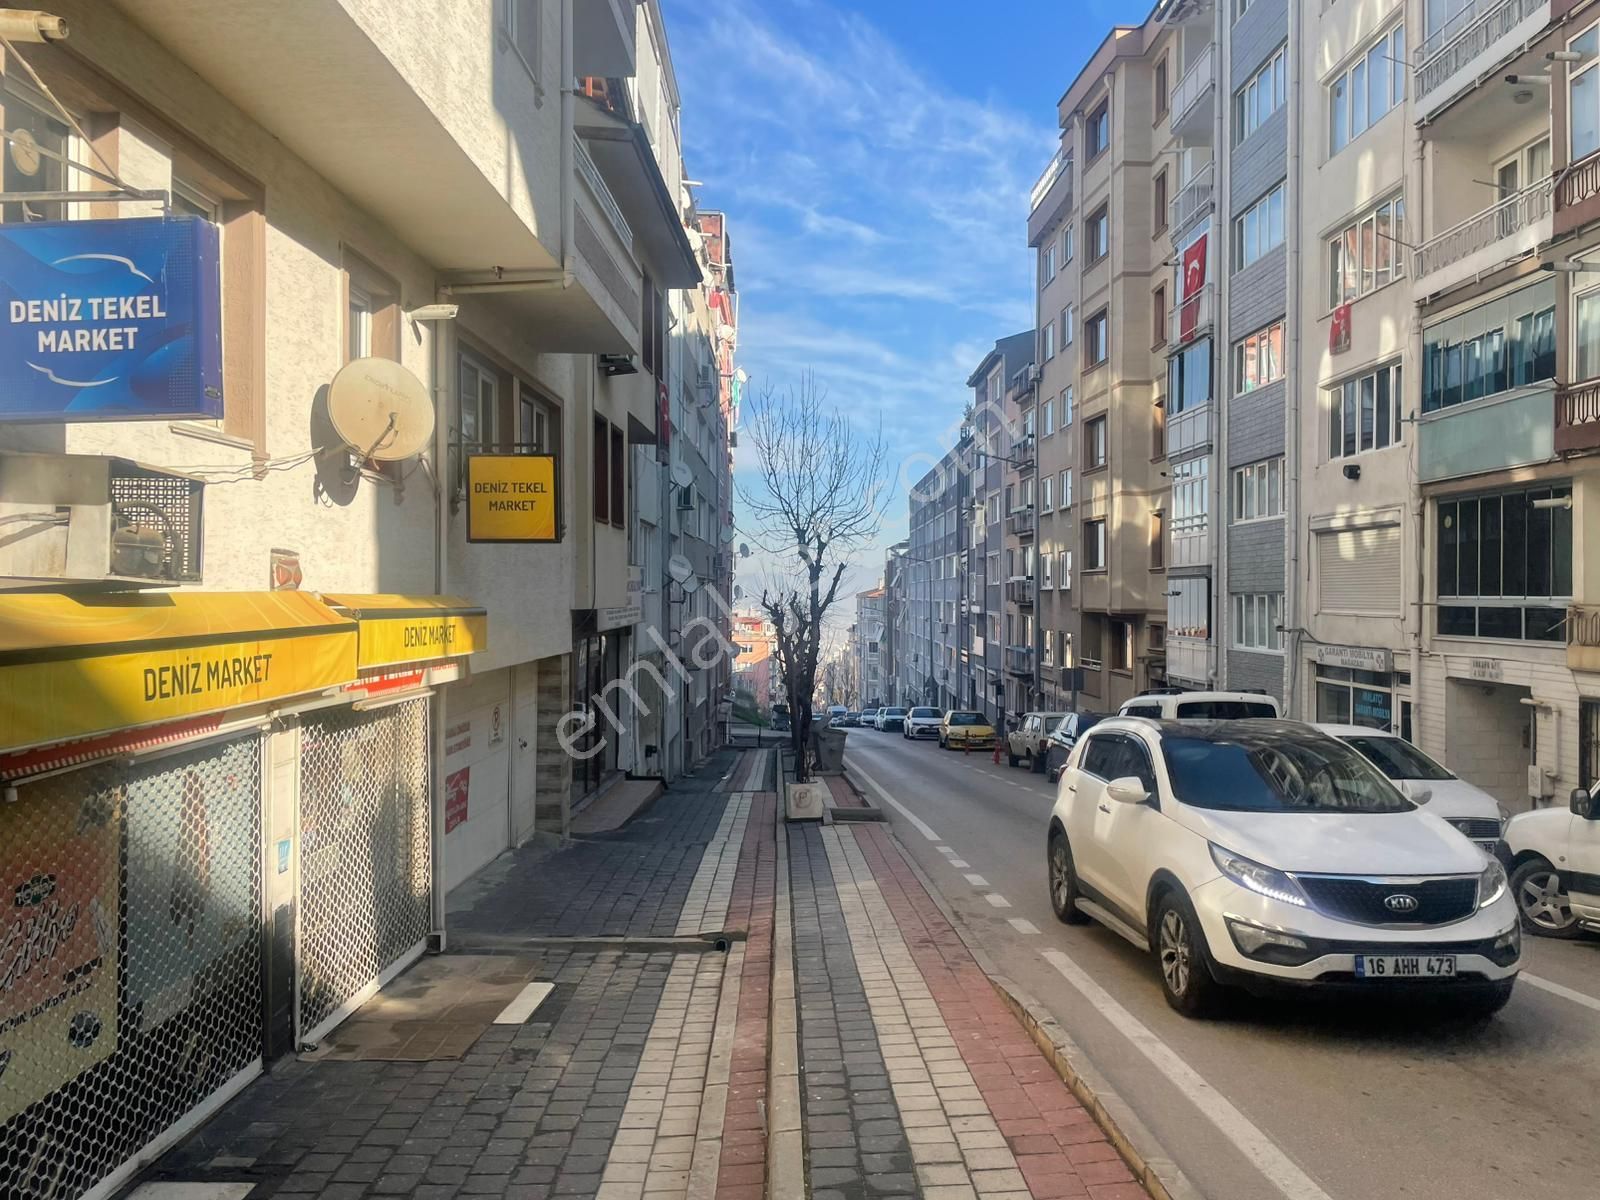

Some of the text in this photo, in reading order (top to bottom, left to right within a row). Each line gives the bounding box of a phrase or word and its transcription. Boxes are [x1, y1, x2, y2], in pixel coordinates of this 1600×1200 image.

[10, 292, 166, 323] DENİZ TEKEL
[38, 327, 138, 352] MARKET
[474, 481, 547, 493] DENİZ TEKEL
[488, 500, 536, 511] MARKET
[404, 621, 456, 647] DENİZ MARKET
[144, 654, 272, 701] DENİZ MARKET
[1390, 898, 1414, 909] KIA
[1369, 958, 1453, 975] 16 AHH 473
